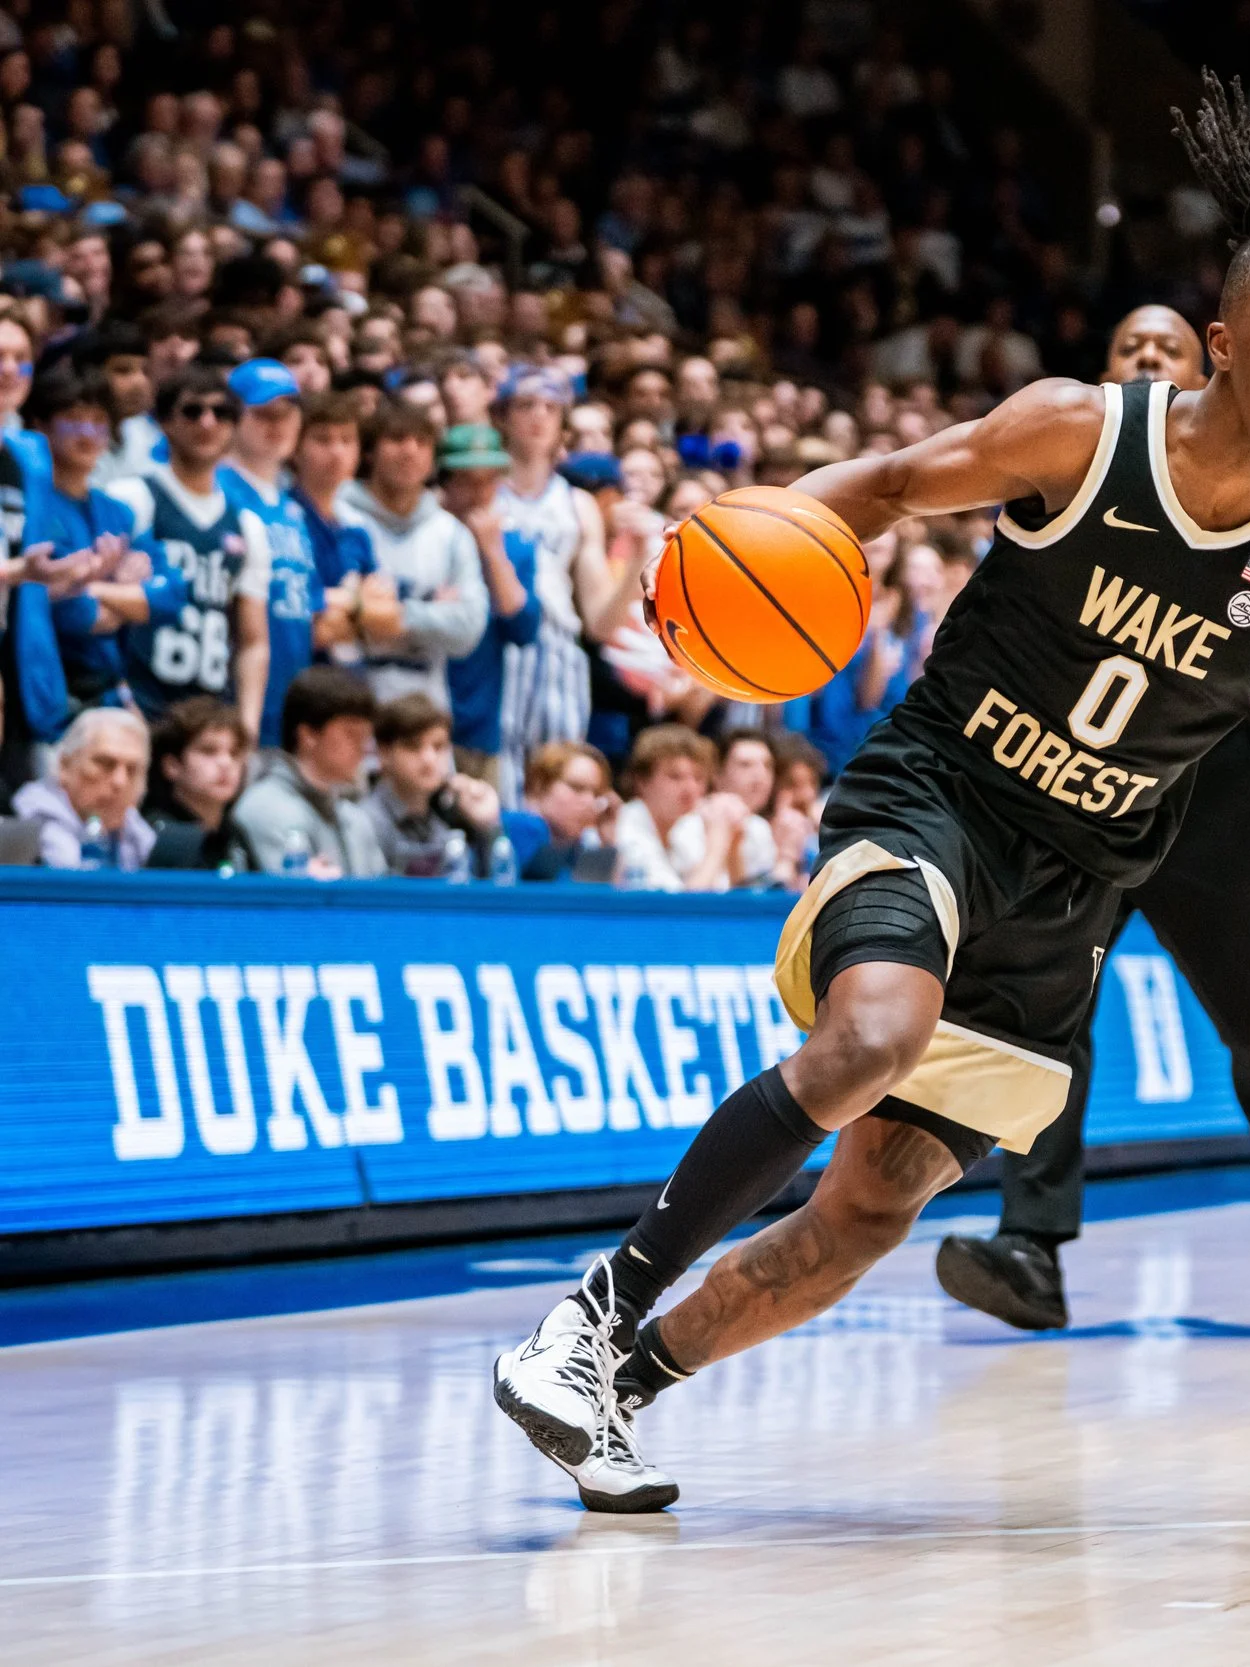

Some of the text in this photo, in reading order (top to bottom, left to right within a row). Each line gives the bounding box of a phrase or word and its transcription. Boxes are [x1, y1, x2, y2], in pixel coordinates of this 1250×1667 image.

[1079, 565, 1232, 679] WAKE
[963, 688, 1159, 818] FOREST
[1067, 655, 1149, 750] 0
[87, 963, 404, 1162] DUKE
